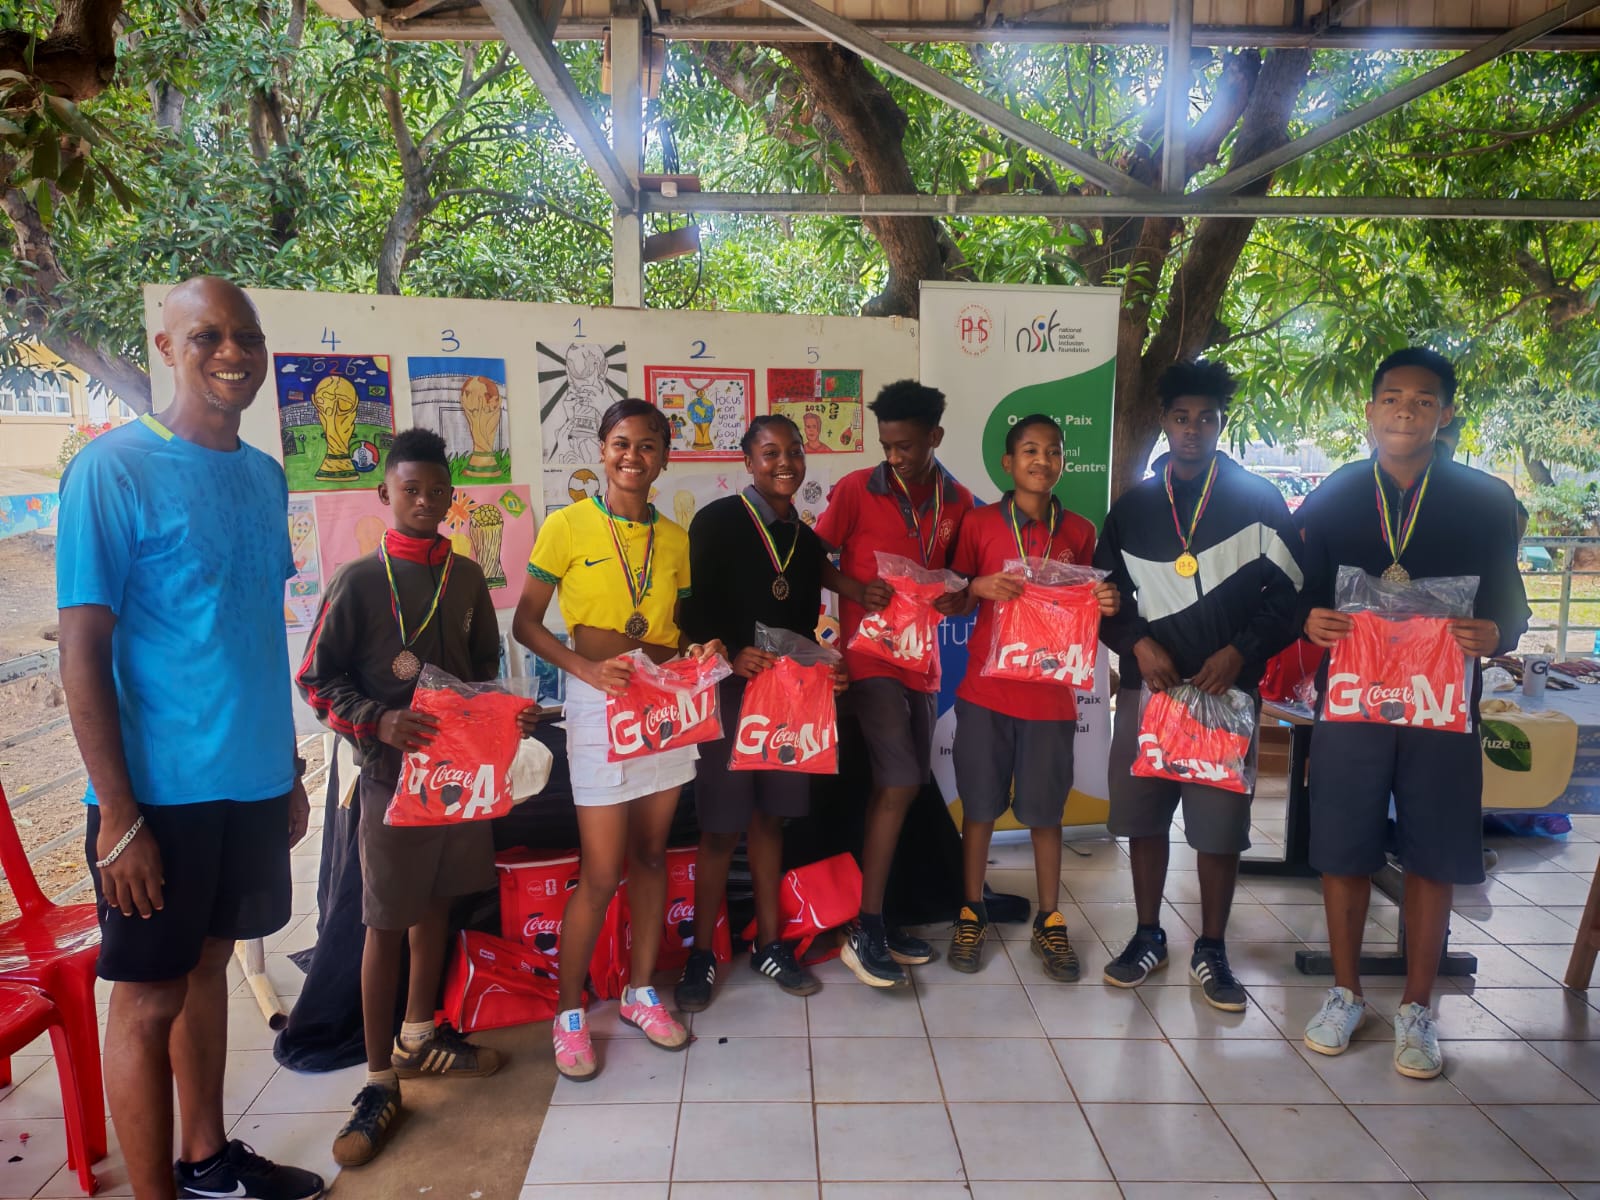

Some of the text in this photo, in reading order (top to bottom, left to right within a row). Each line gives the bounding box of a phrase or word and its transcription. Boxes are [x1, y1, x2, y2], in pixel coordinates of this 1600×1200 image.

[573, 317, 586, 338] 1
[321, 326, 342, 352] 4
[441, 329, 461, 352] 3
[689, 340, 717, 359] 2
[806, 346, 820, 364] 5
[298, 357, 357, 376] 2026
[718, 413, 736, 425] your
[1065, 414, 1093, 425] Paix
[1065, 461, 1107, 473] Centre
[1076, 695, 1102, 705] Paix
